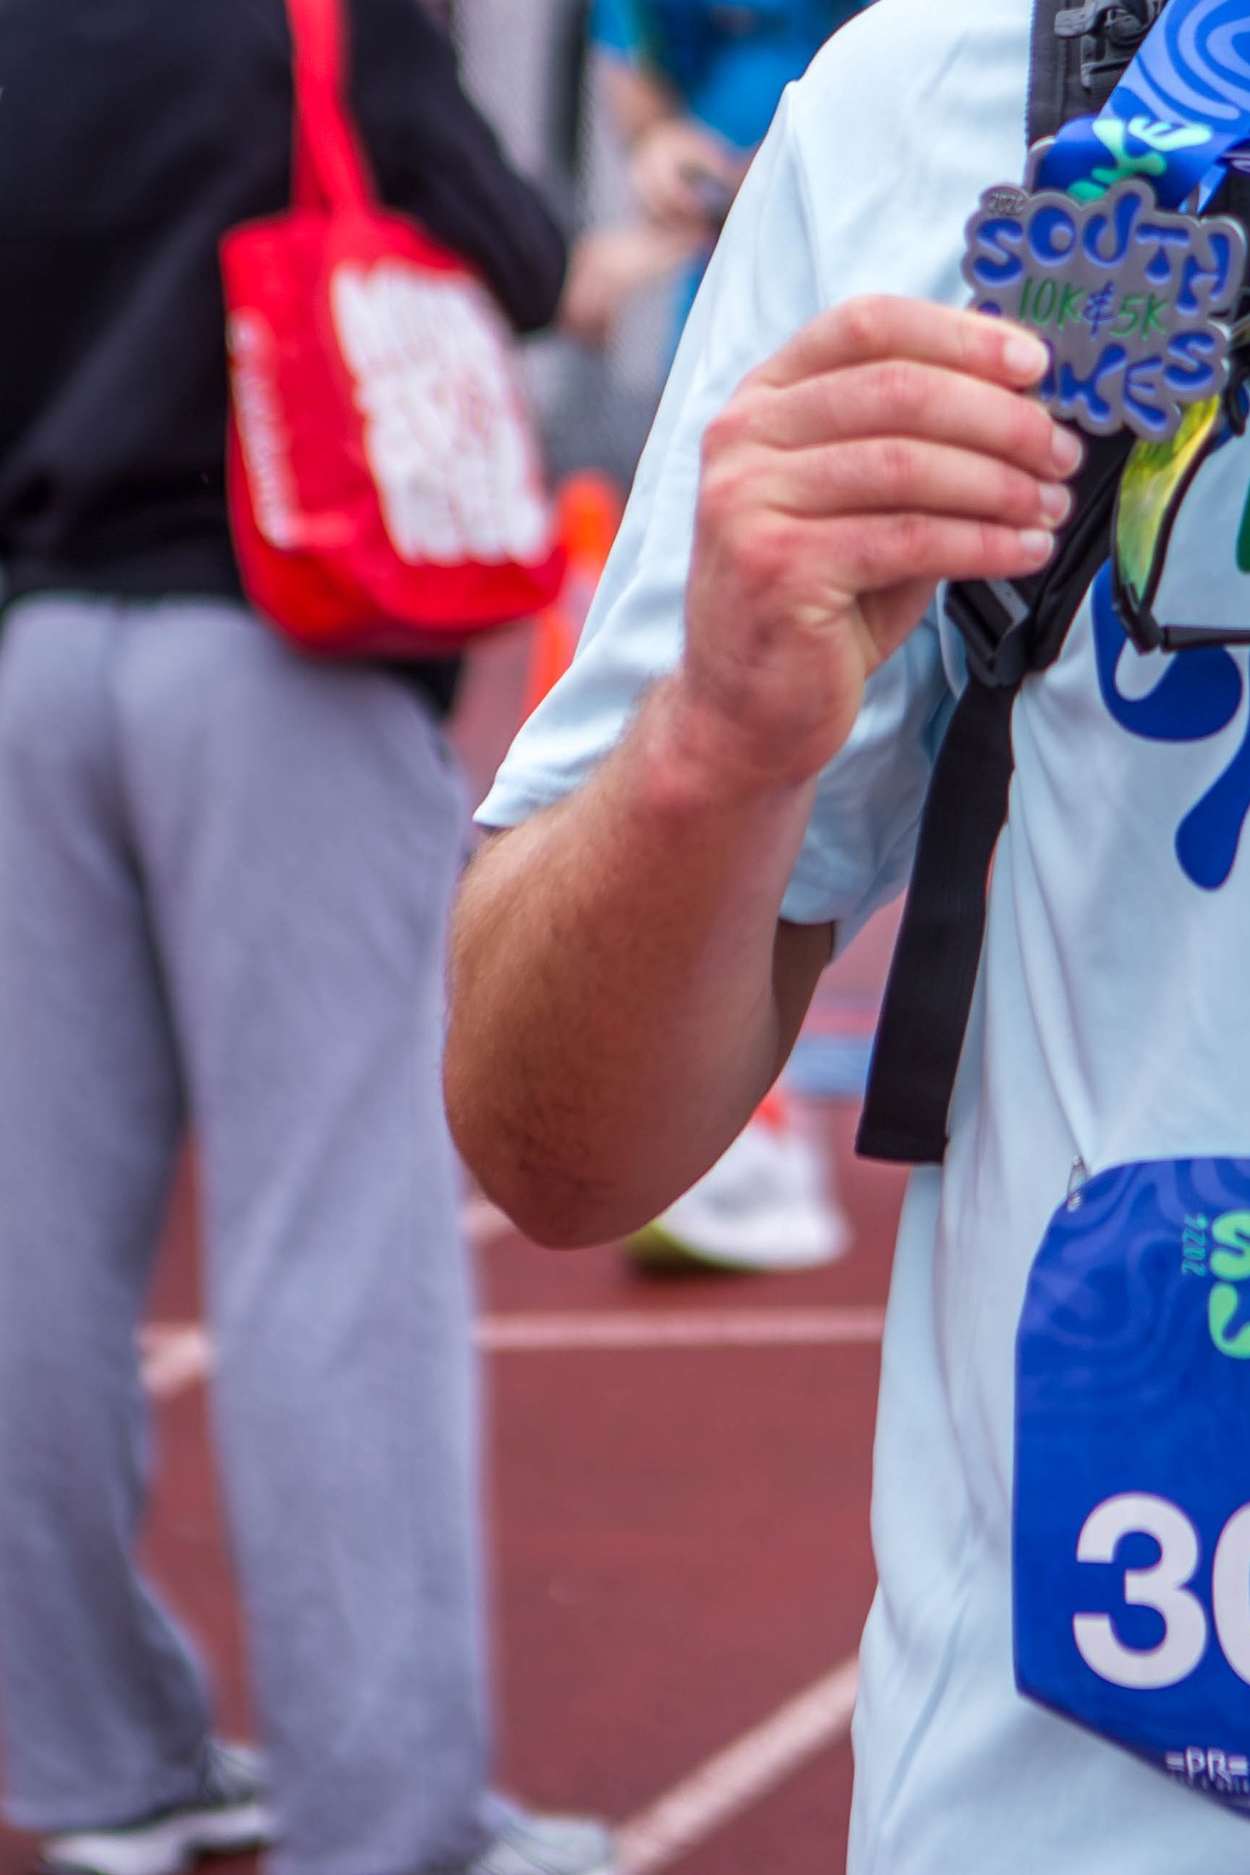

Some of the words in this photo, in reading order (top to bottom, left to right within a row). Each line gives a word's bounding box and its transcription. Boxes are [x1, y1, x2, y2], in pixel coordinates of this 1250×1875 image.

[973, 192, 1232, 317] SOUTH
[1018, 277, 1085, 332] 10K
[1083, 280, 1117, 343] &
[1110, 293, 1170, 341] 5K
